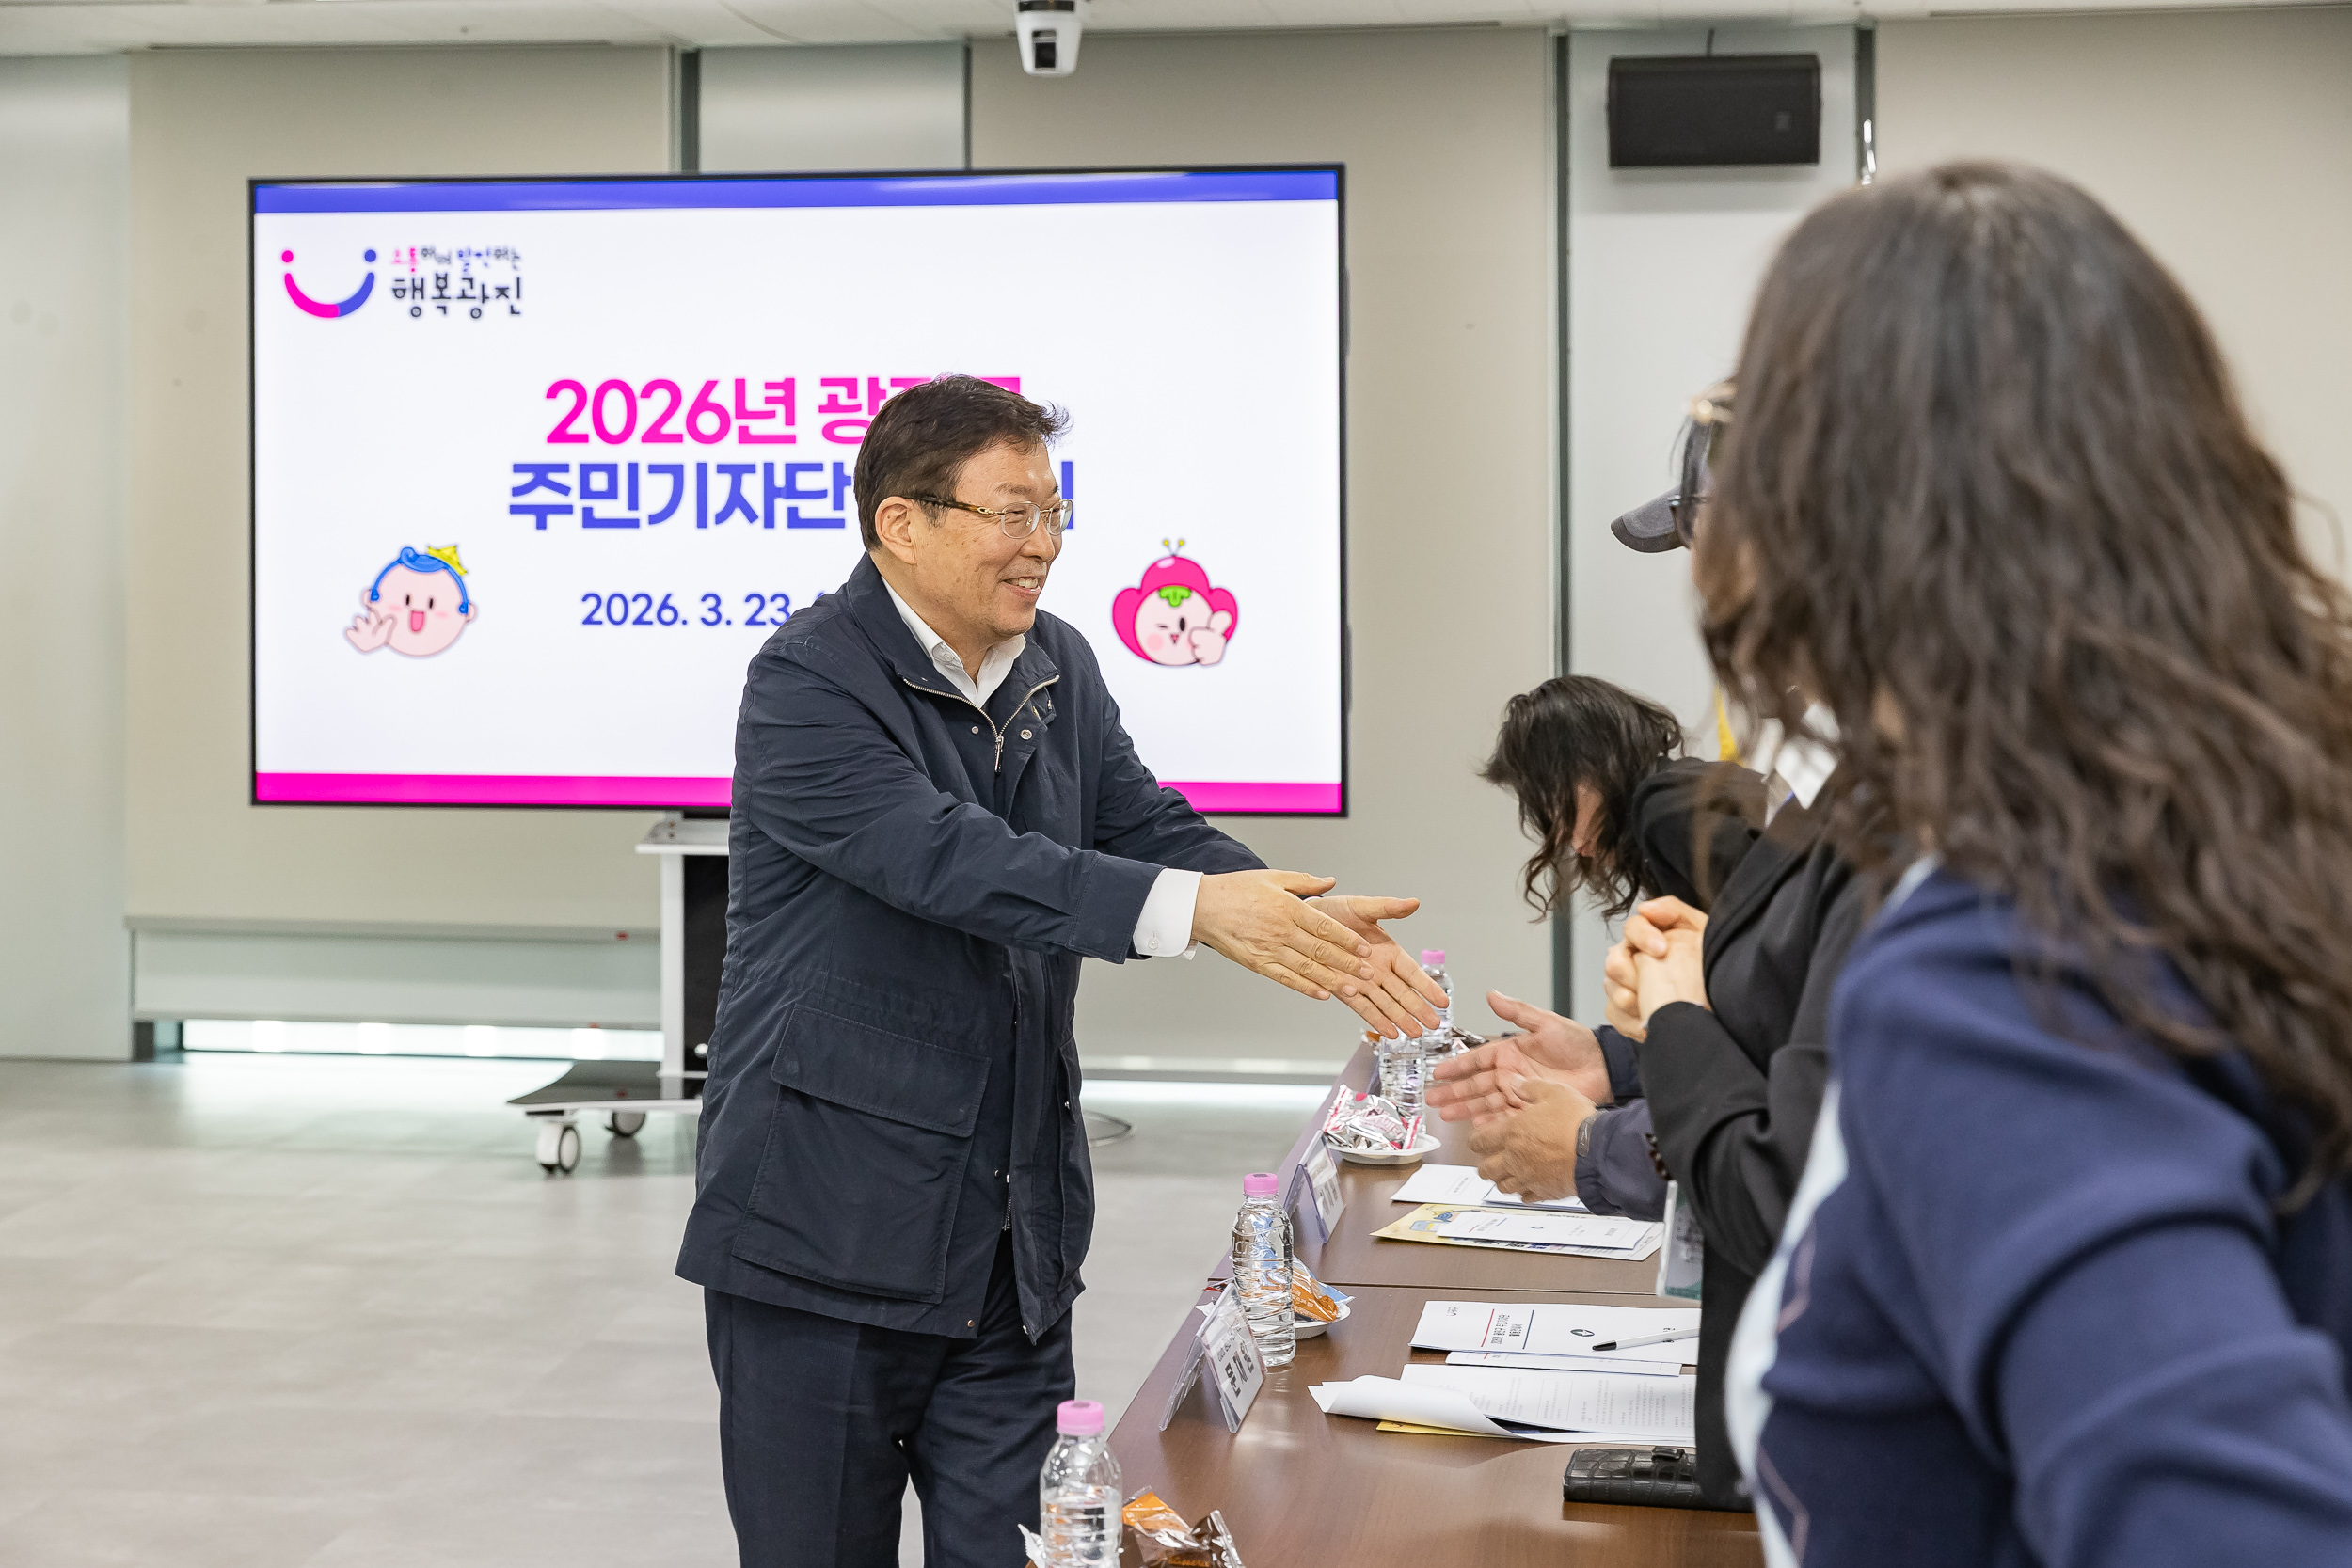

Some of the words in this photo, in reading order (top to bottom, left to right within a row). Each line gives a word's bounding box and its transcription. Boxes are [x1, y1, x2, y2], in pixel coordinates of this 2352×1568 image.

[391, 272, 521, 319] 행복광진
[546, 377, 797, 445] 2026년
[509, 462, 853, 530] 주민기자단
[580, 593, 688, 626] 2026.
[700, 593, 732, 626] 3.
